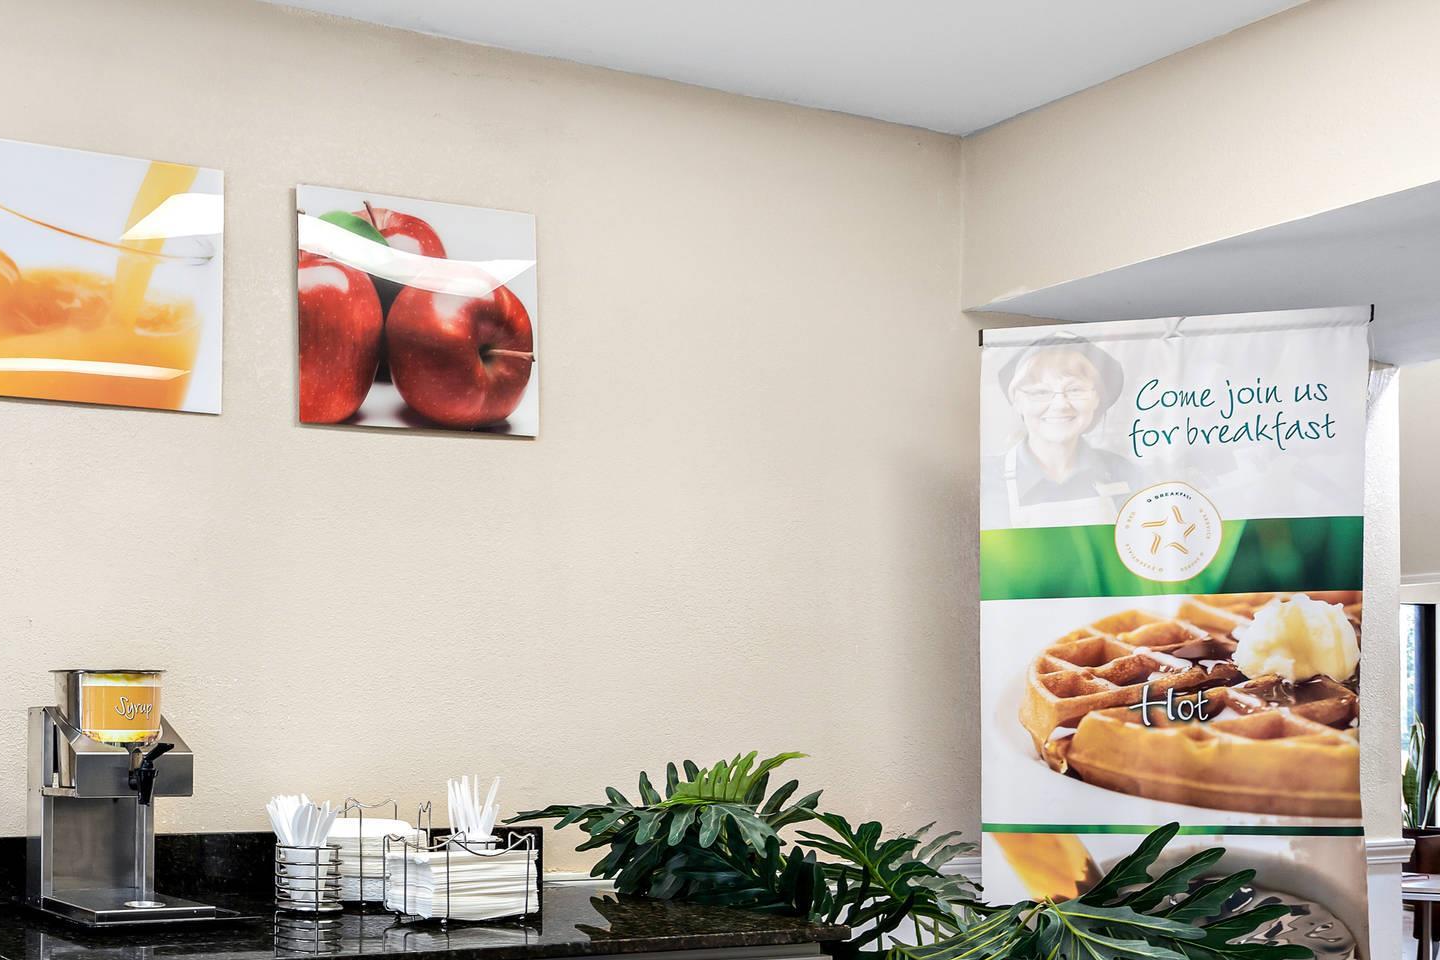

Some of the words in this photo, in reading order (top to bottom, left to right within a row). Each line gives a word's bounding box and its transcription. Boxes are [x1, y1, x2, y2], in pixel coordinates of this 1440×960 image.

[1136, 378, 1215, 411] Come
[1220, 377, 1282, 420] join
[1294, 382, 1328, 403] us
[1128, 418, 1179, 458] for
[1186, 411, 1336, 451] breakfast
[114, 696, 153, 720] Syrup
[1128, 684, 1209, 727] Hot
